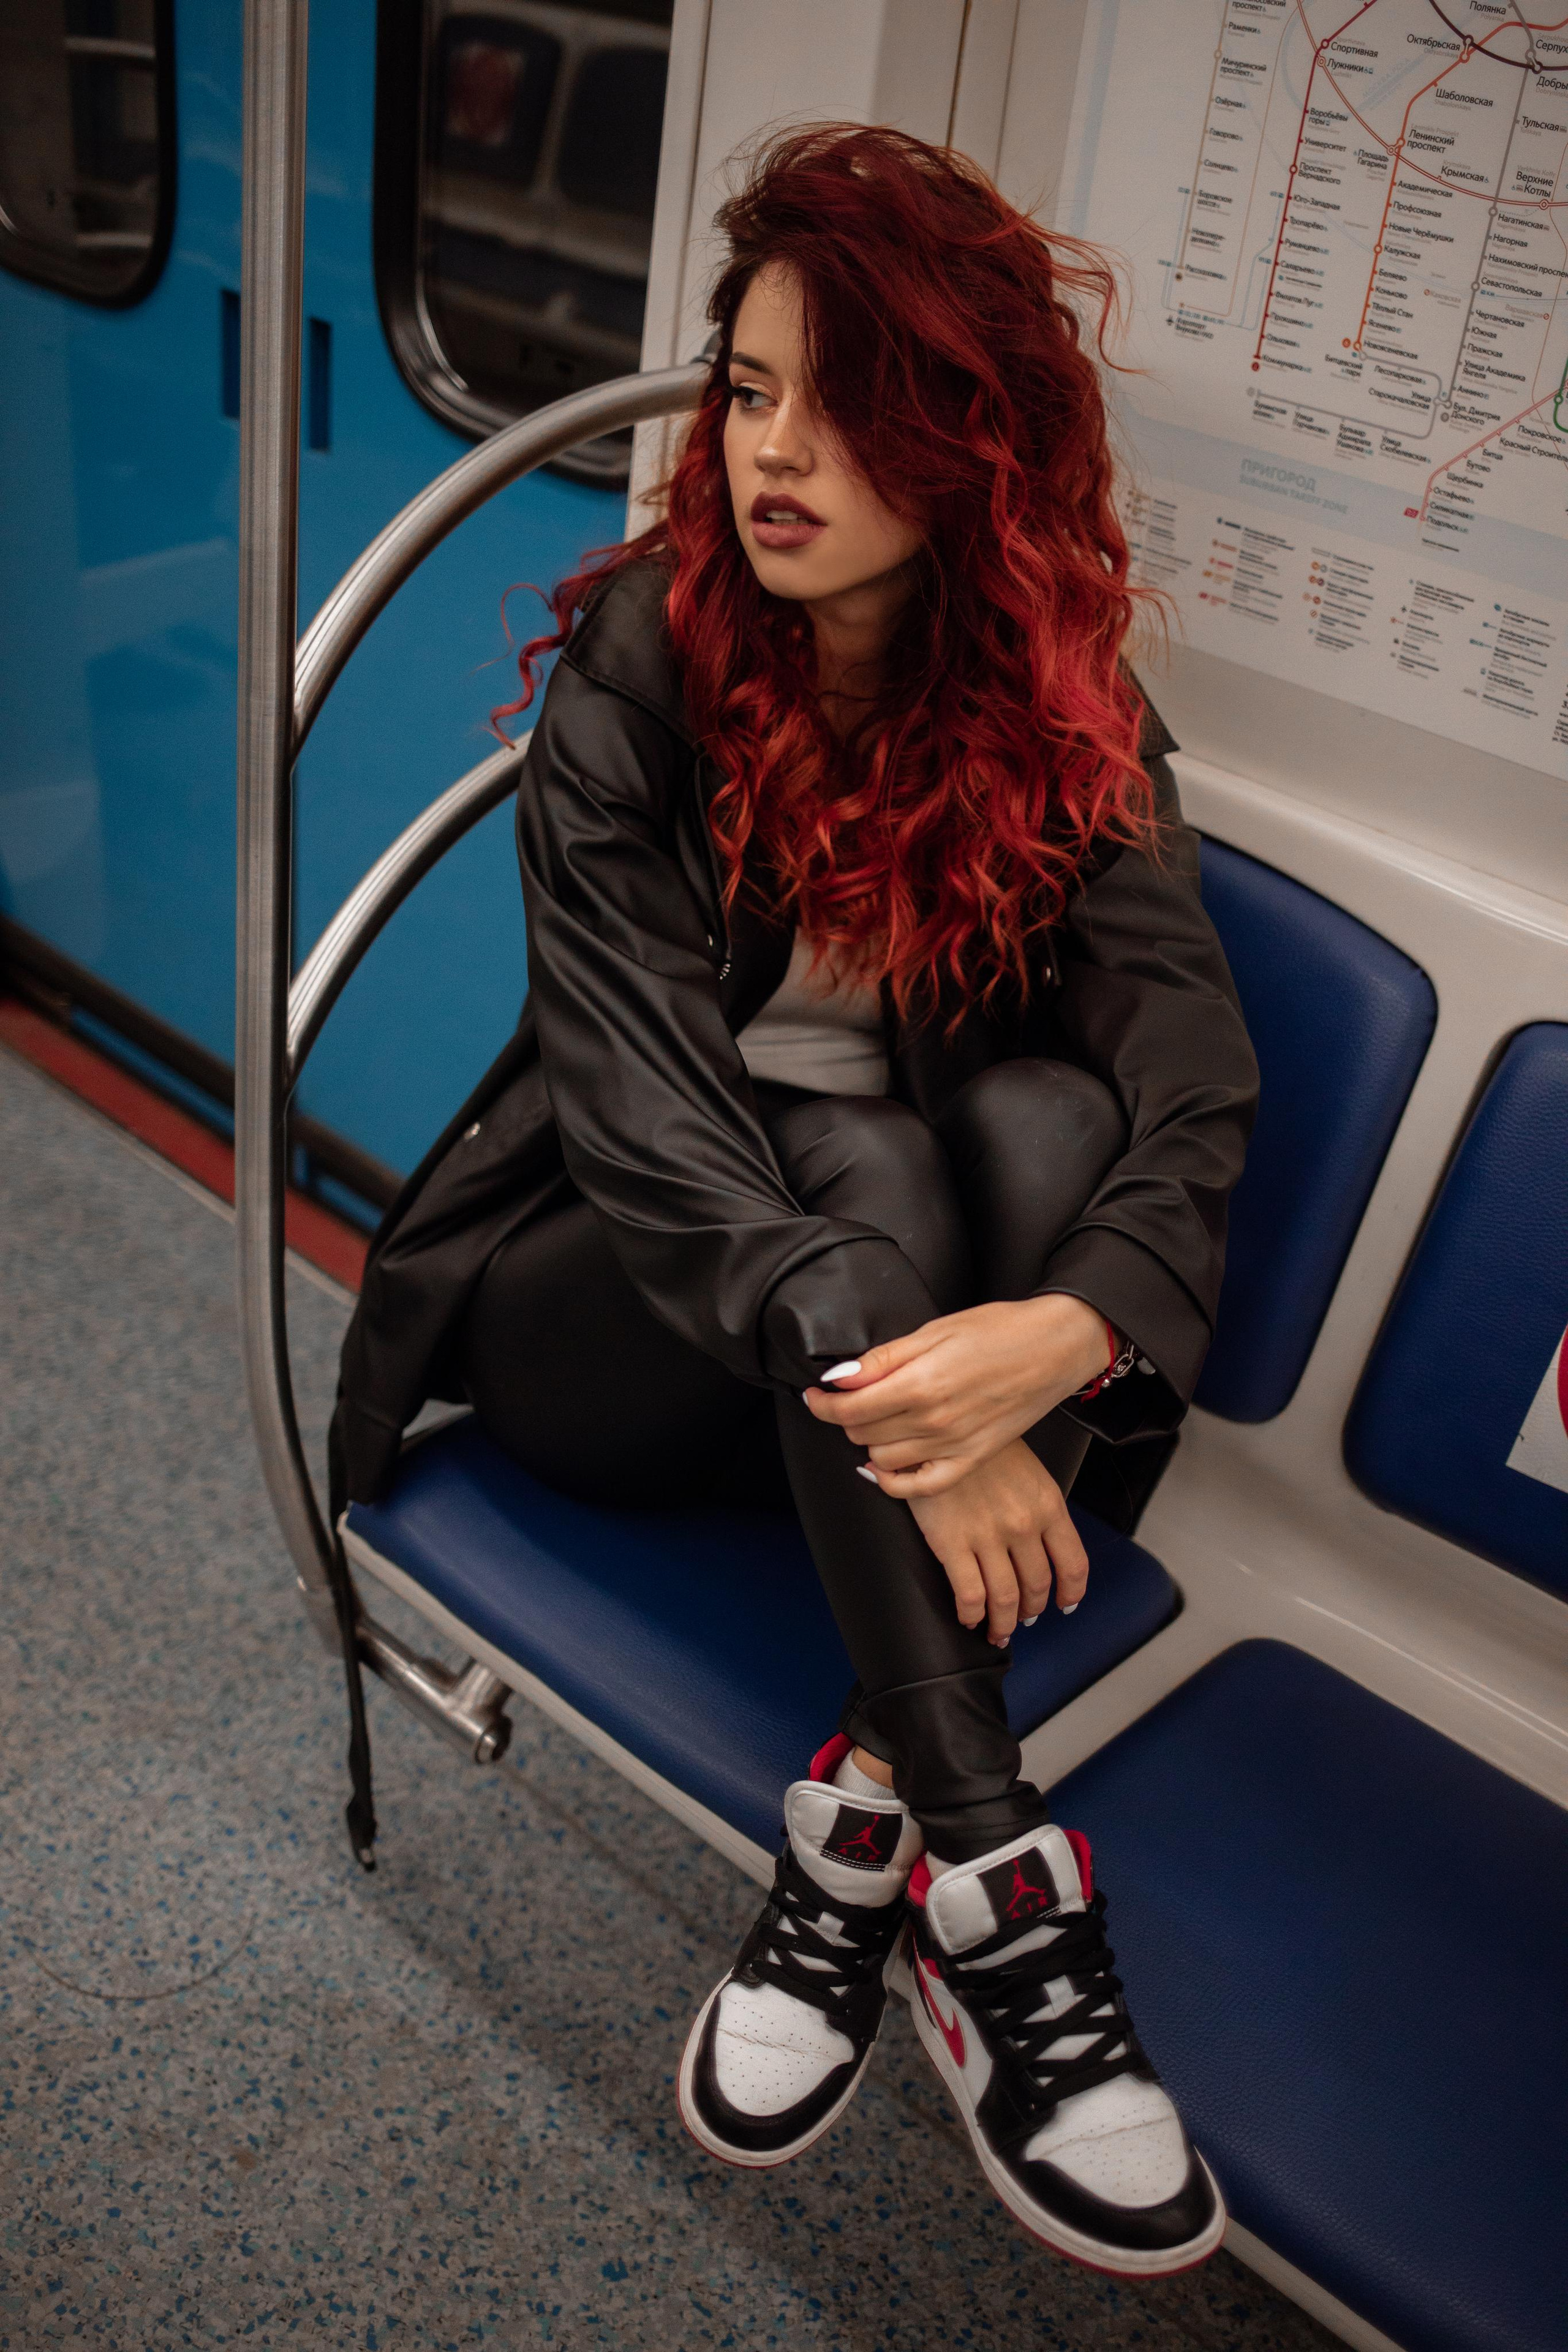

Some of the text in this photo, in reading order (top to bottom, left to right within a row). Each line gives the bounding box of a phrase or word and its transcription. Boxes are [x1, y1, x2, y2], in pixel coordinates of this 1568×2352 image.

[1232, 1, 1262, 12] проспект
[1470, 1, 1506, 15] Полянка
[1229, 22, 1257, 33] Раменки
[1331, 42, 1378, 58] Спортивная
[1407, 34, 1460, 51] Октябрьская
[1327, 58, 1364, 73] Лужники
[1436, 88, 1493, 107] Шаболовская
[1310, 108, 1348, 121] Воробьёвы
[1521, 116, 1559, 132] Тульская
[1305, 137, 1346, 152] Университет
[1409, 129, 1455, 146] Ленинский
[1407, 139, 1446, 154] проспект
[1358, 149, 1389, 162] Площадь
[1300, 162, 1332, 175] Проспект
[1357, 158, 1387, 170] Гагарина
[1441, 165, 1484, 183] Крымская
[1516, 171, 1554, 187] Верхние
[1398, 180, 1452, 198] Академическая
[1523, 184, 1551, 197] Котлы
[1294, 194, 1341, 210] Юго-Западная
[1393, 201, 1442, 219] Профсоюзная
[1498, 214, 1543, 230] Нагатинская
[1389, 223, 1411, 233] Новые
[1413, 227, 1454, 243] Черёмушки
[1493, 233, 1528, 247] Нагорная
[1384, 245, 1420, 259] Калужская
[1488, 254, 1537, 271] Нахимовский
[1379, 268, 1408, 281] Беляево
[1376, 285, 1408, 300] Коньково
[1482, 277, 1542, 297] Севастопольская
[1397, 308, 1413, 318] Стан
[1476, 309, 1525, 328] Чертановская
[1471, 326, 1497, 339] Южная
[1468, 343, 1502, 358] Пражская
[1464, 360, 1525, 382] Улица Академика
[1458, 385, 1484, 398] Аннино
[1451, 410, 1485, 425] Донского
[1469, 407, 1501, 421] Дмитрия
[1518, 425, 1562, 443] Покровское
[1500, 437, 1531, 451] Красный
[1482, 448, 1503, 461] Битца
[1466, 460, 1491, 473] Бутово
[1240, 459, 1316, 493] ПРИГОРОД
